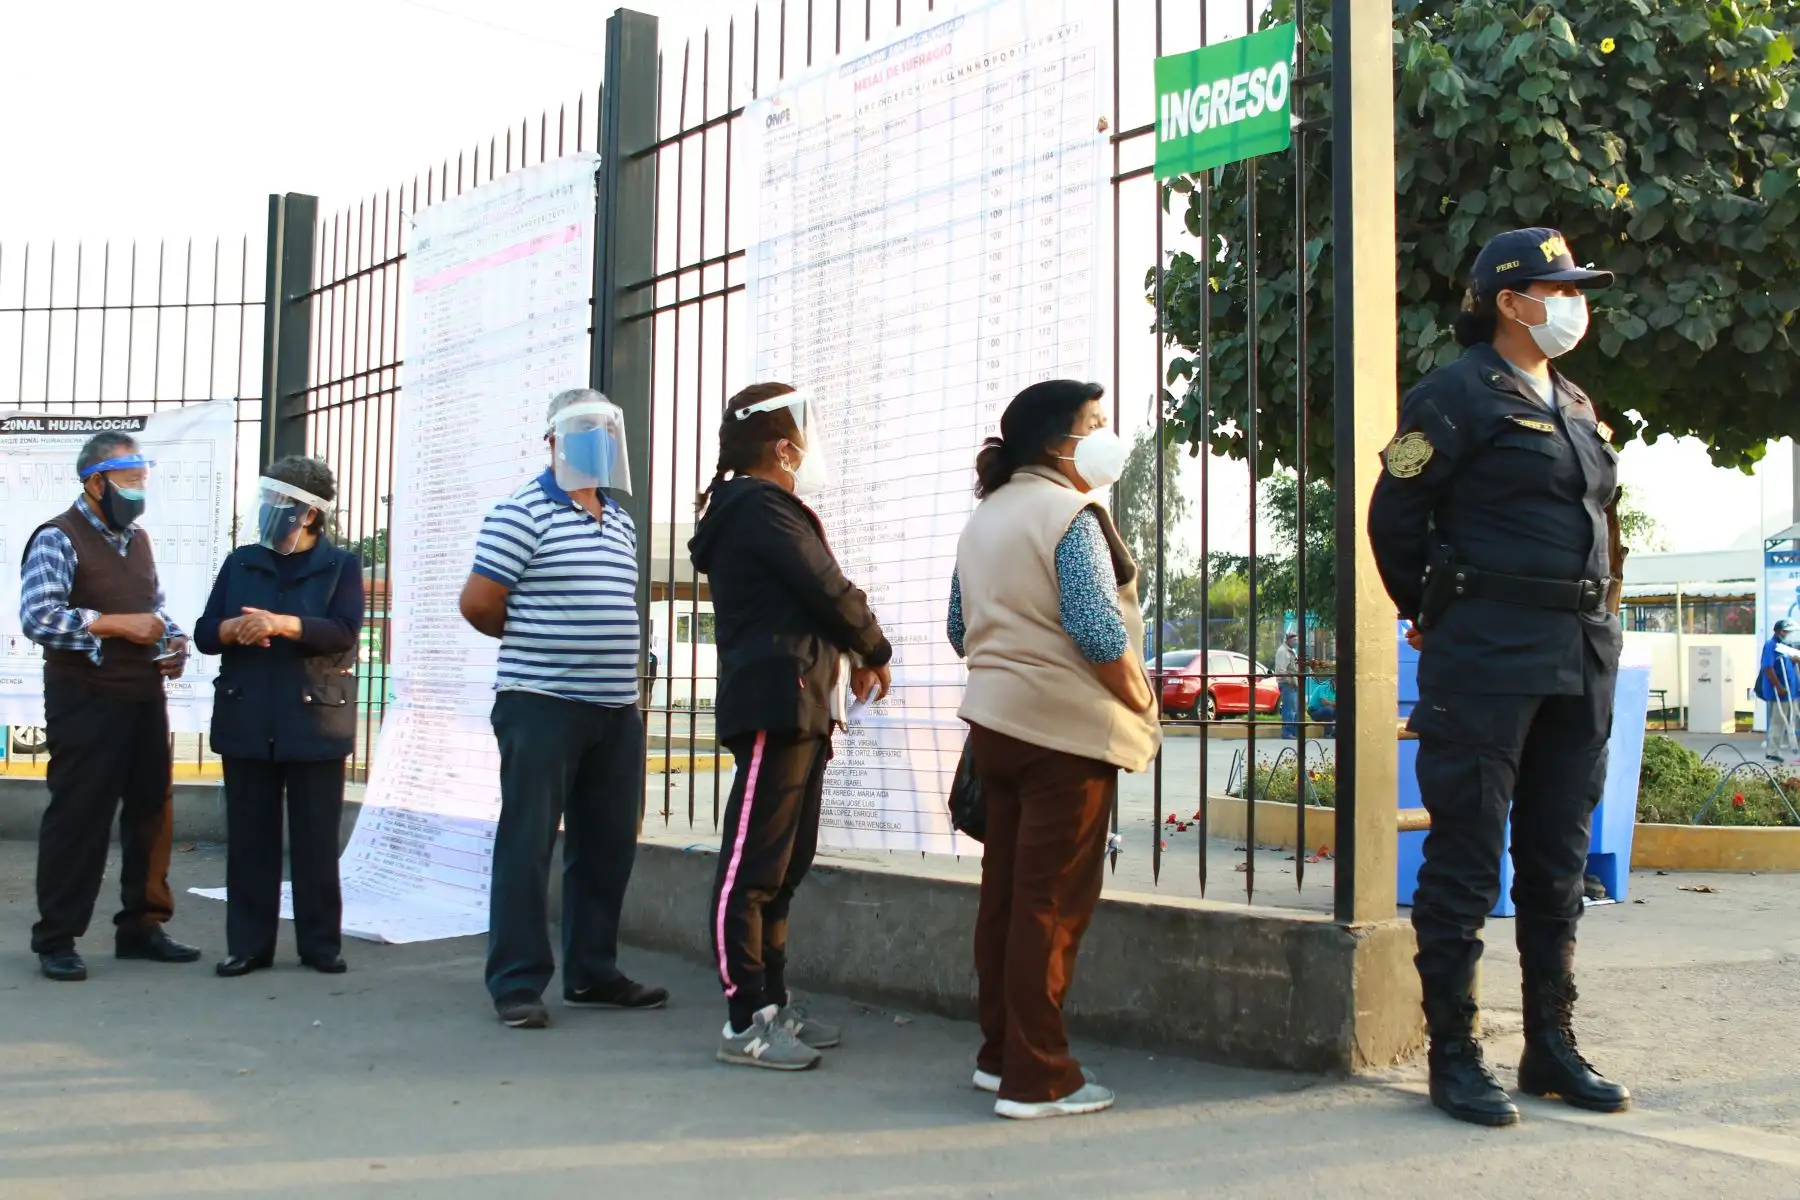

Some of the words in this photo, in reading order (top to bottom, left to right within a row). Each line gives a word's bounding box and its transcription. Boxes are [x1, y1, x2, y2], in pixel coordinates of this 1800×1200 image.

[886, 65, 900, 80] DE
[902, 42, 952, 73] SUFRAGIO
[1161, 60, 1288, 143] INGRESO
[766, 107, 790, 129] ONPE
[1496, 260, 1520, 273] PERU
[0, 420, 44, 431] ZONAL
[48, 420, 140, 430] HUIRACOCHA
